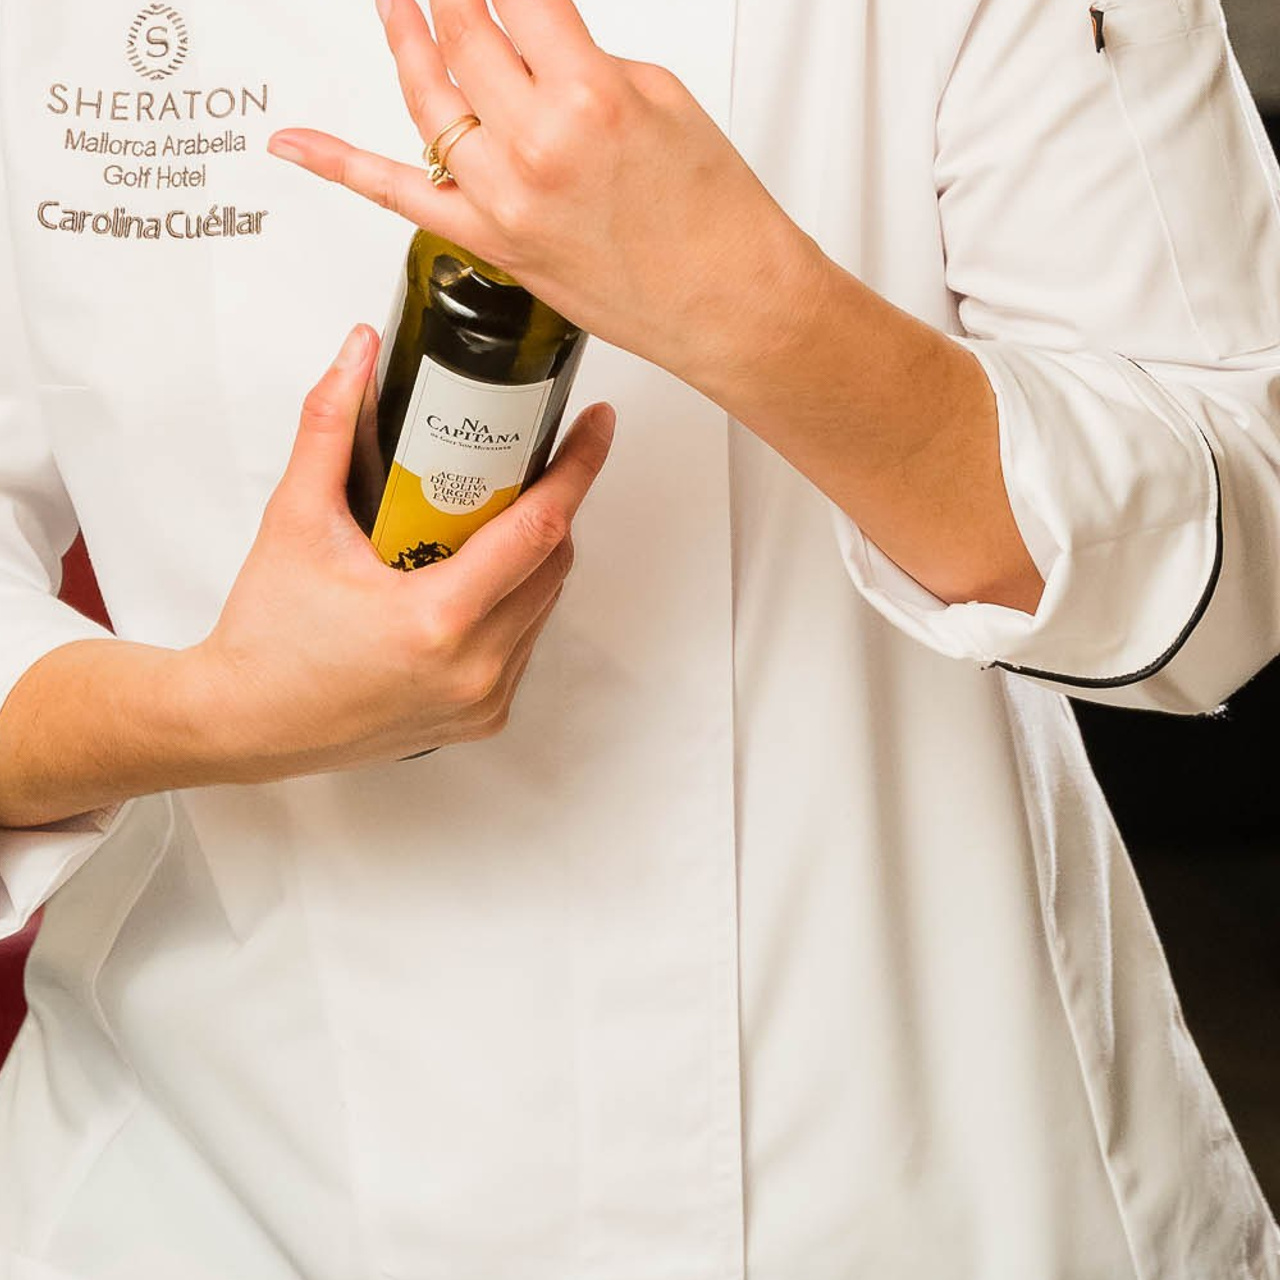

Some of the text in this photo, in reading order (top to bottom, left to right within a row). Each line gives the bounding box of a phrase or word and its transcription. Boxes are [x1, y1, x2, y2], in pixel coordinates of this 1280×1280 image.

[146, 26, 170, 58] S
[46, 83, 268, 122] SHERATON
[64, 128, 246, 157] Mallorca Arabella
[103, 164, 206, 190] Golf Hotel
[37, 200, 269, 239] Carolina Cuéllar
[426, 415, 520, 444] CAPITANA
[461, 417, 489, 433] NA
[430, 475, 487, 491] DE OLIVA
[437, 471, 486, 485] ACEITE
[433, 484, 482, 499] VIRGEN
[433, 493, 475, 506] EXTRA
